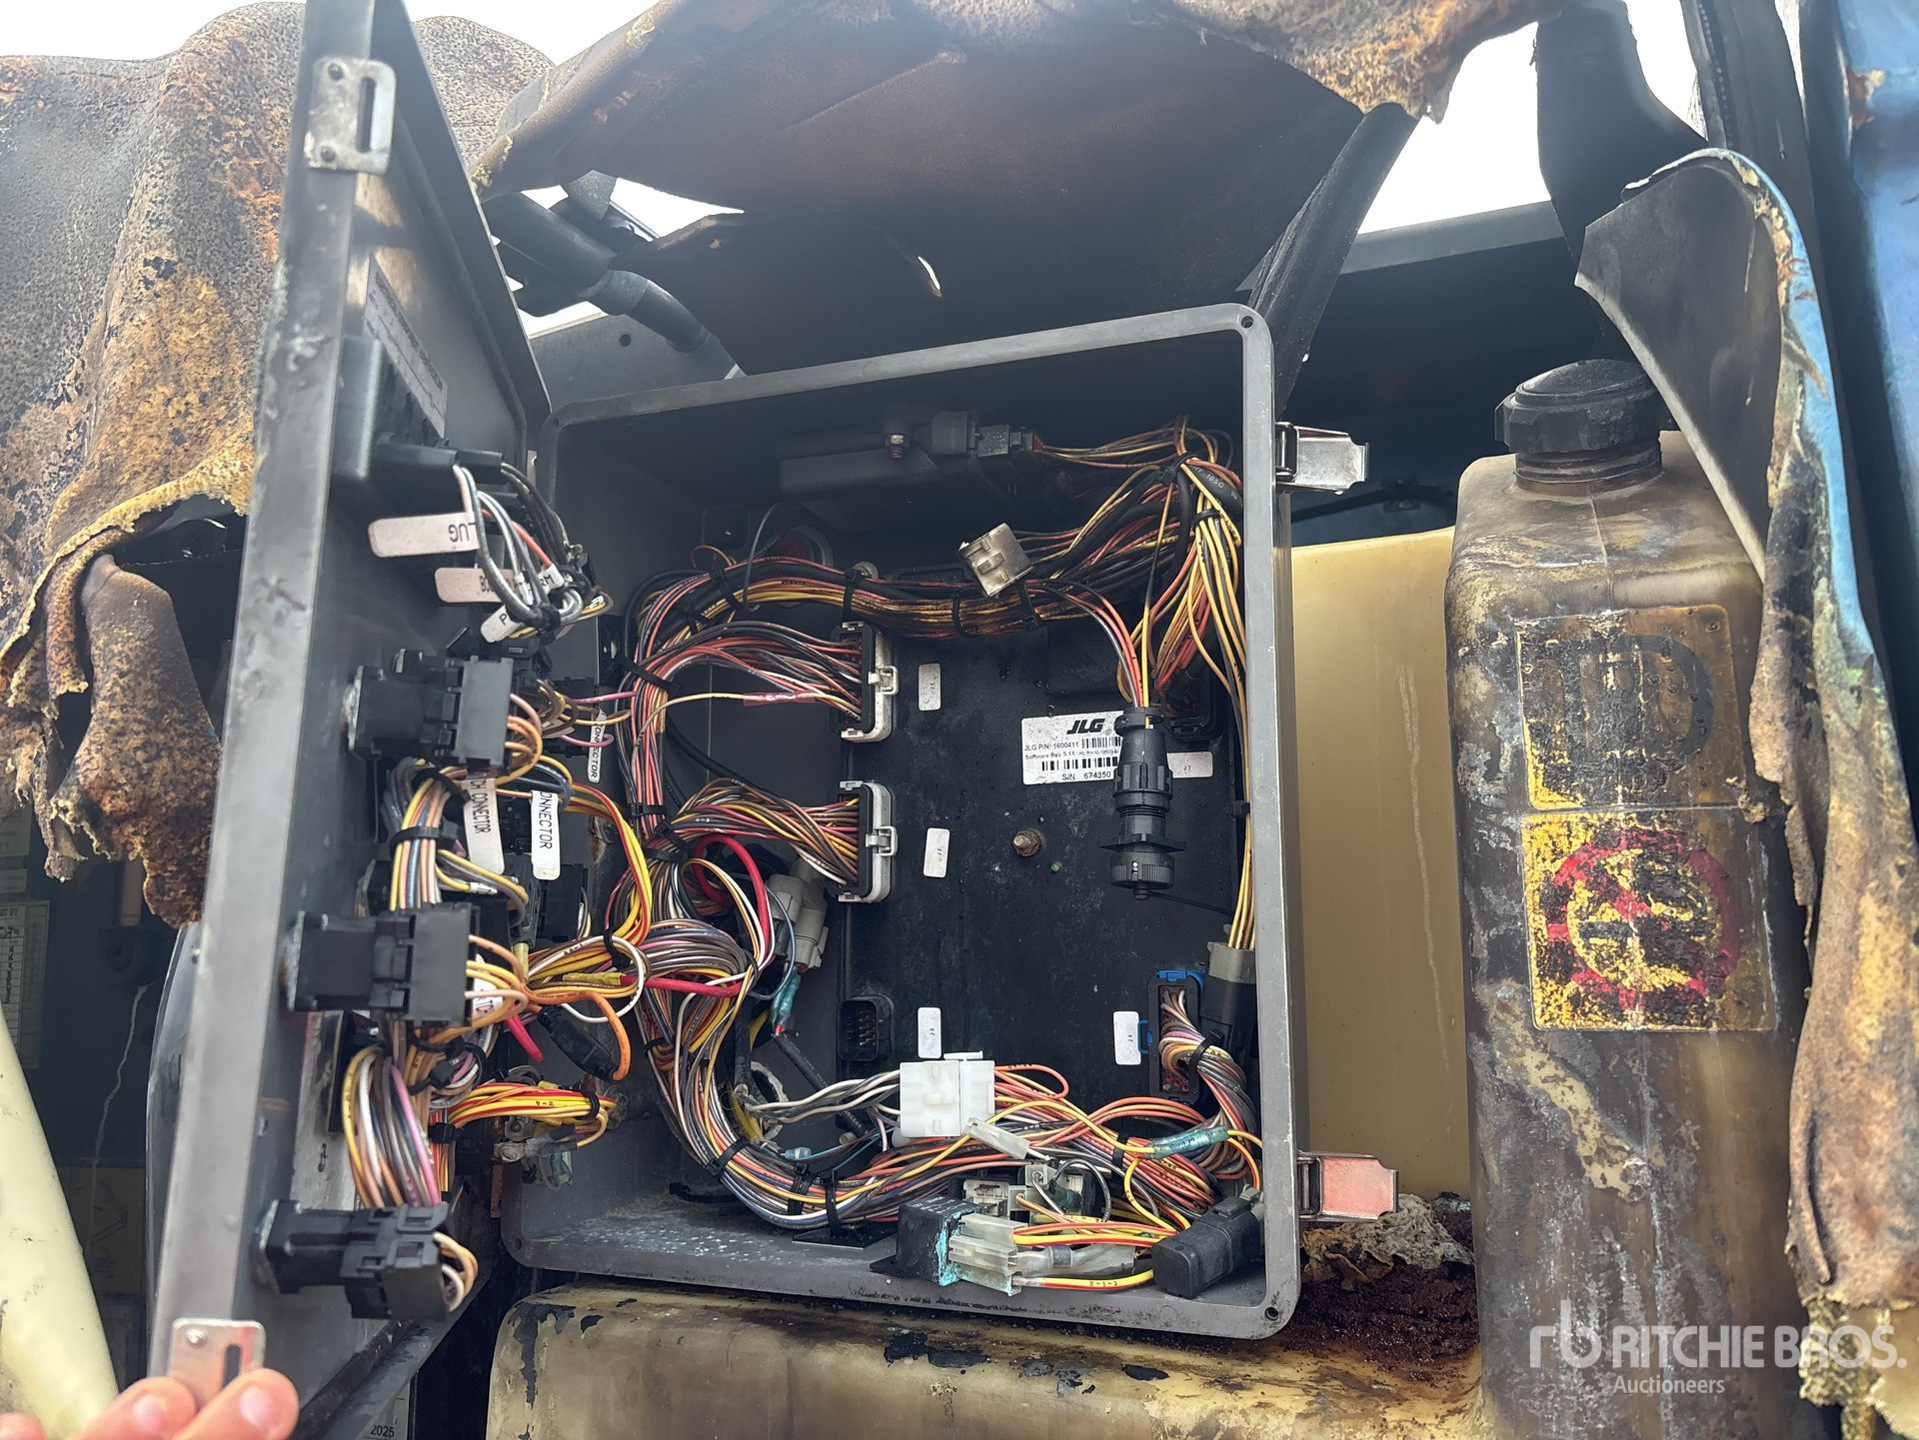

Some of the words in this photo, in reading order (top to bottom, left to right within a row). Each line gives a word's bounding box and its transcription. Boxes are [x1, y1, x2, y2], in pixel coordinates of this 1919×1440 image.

[1066, 718, 1105, 735] JLG
[1025, 743, 1037, 751] JLG
[1053, 741, 1079, 750] 1600411
[1083, 770, 1112, 780] 674350
[471, 792, 491, 834] CONNECTOR
[370, 1424, 395, 1438] 2025
